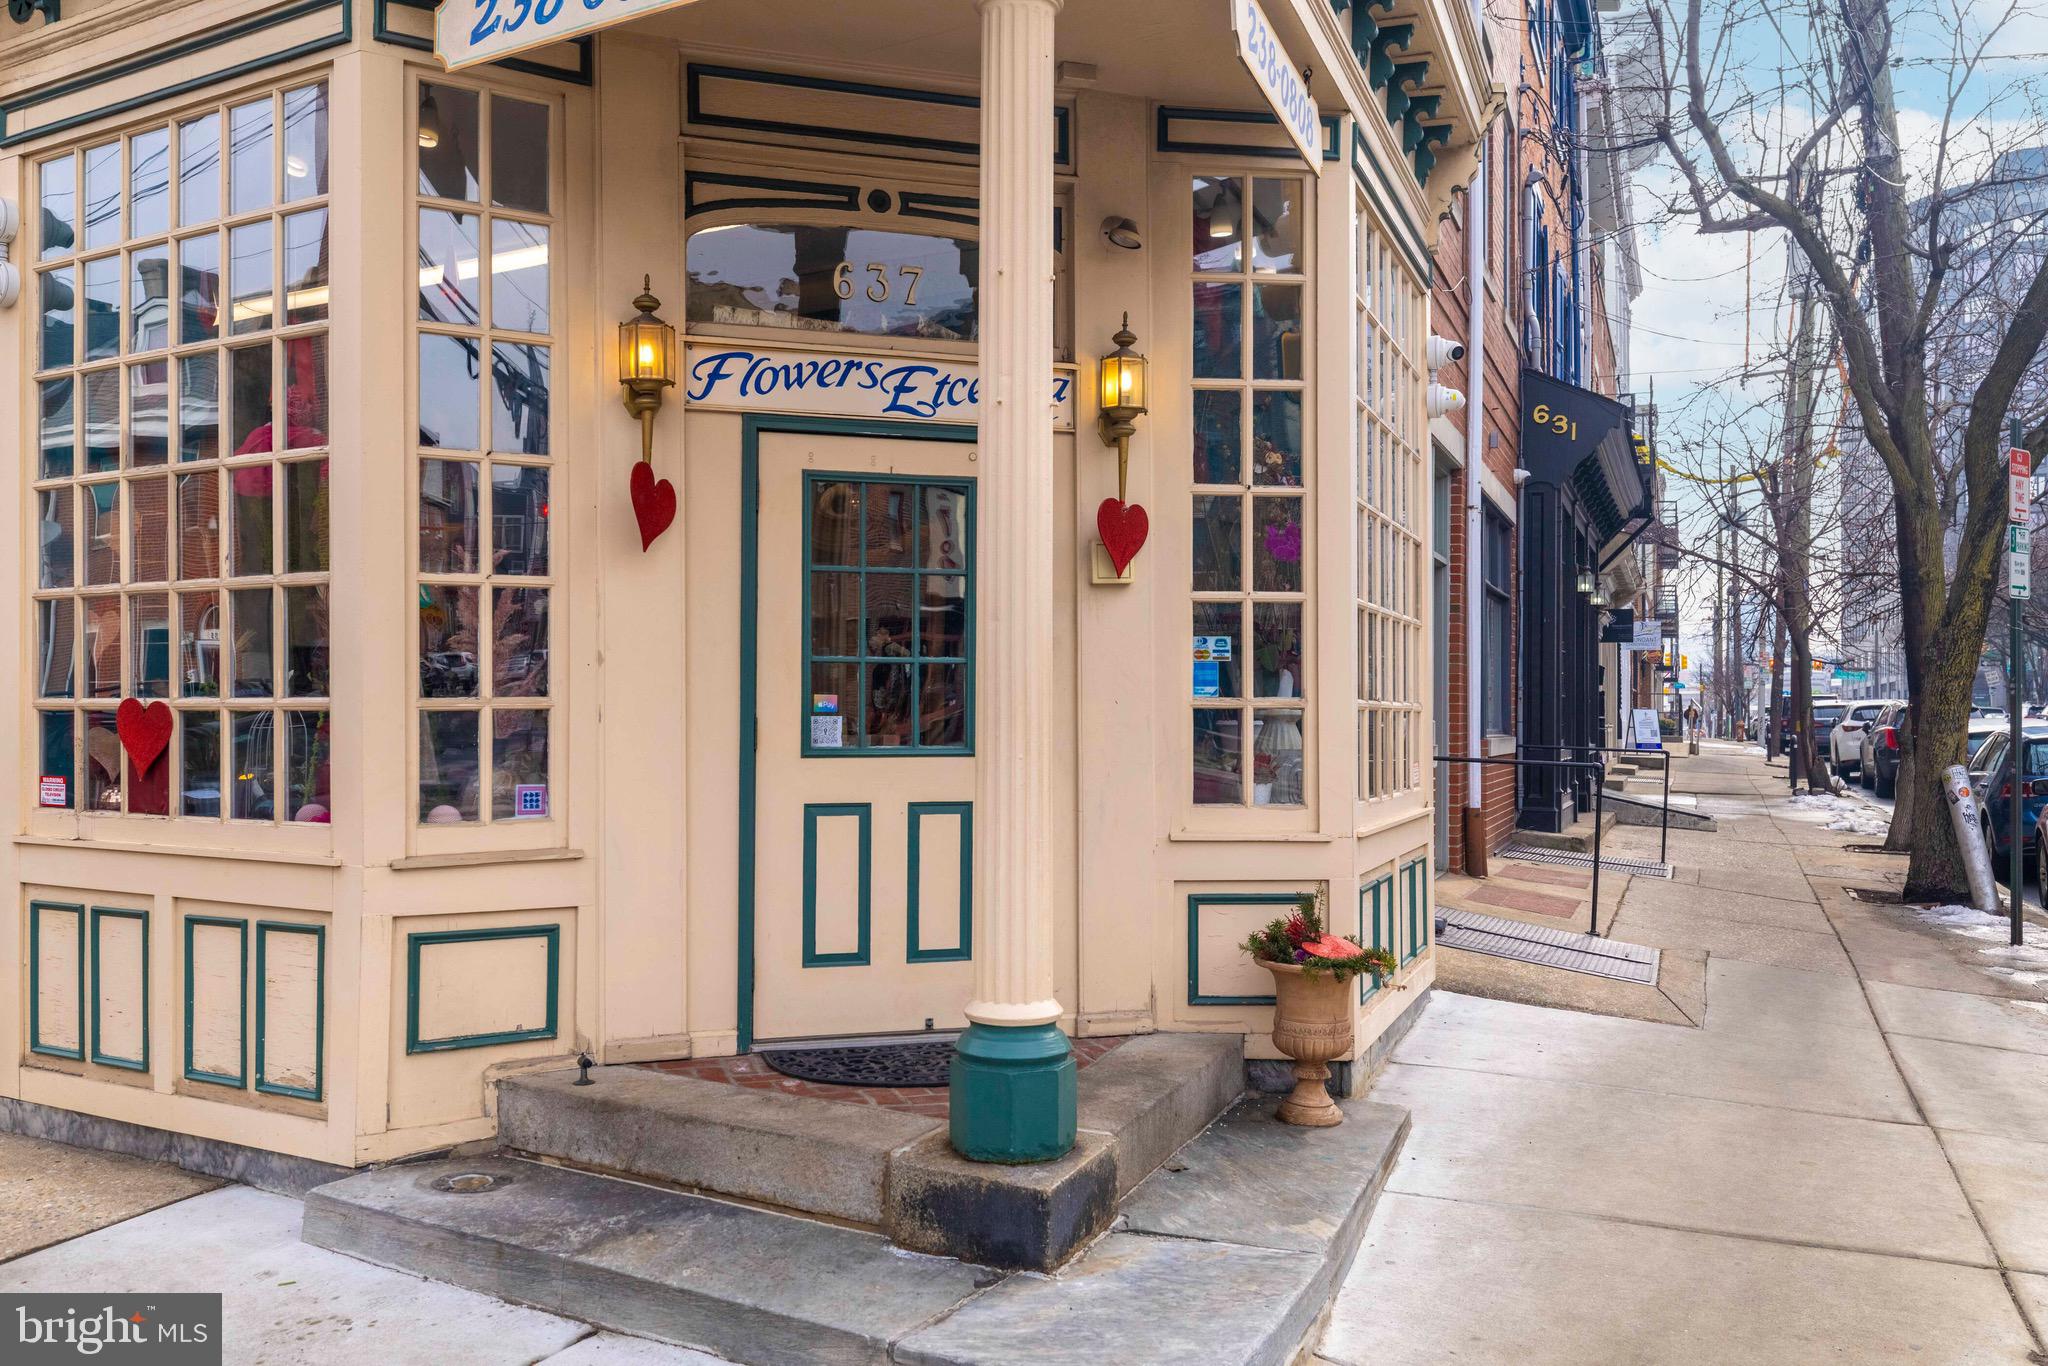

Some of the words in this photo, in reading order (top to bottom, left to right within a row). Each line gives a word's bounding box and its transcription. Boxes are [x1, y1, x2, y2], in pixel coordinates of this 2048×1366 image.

[833, 260, 925, 306] 637
[687, 351, 885, 401] Flowers
[880, 364, 1070, 419] Etcea
[1533, 404, 1577, 441] 631
[2011, 462, 2029, 475] STOPPING
[2015, 479, 2024, 490] ANY
[2015, 491, 2025, 504] TIME
